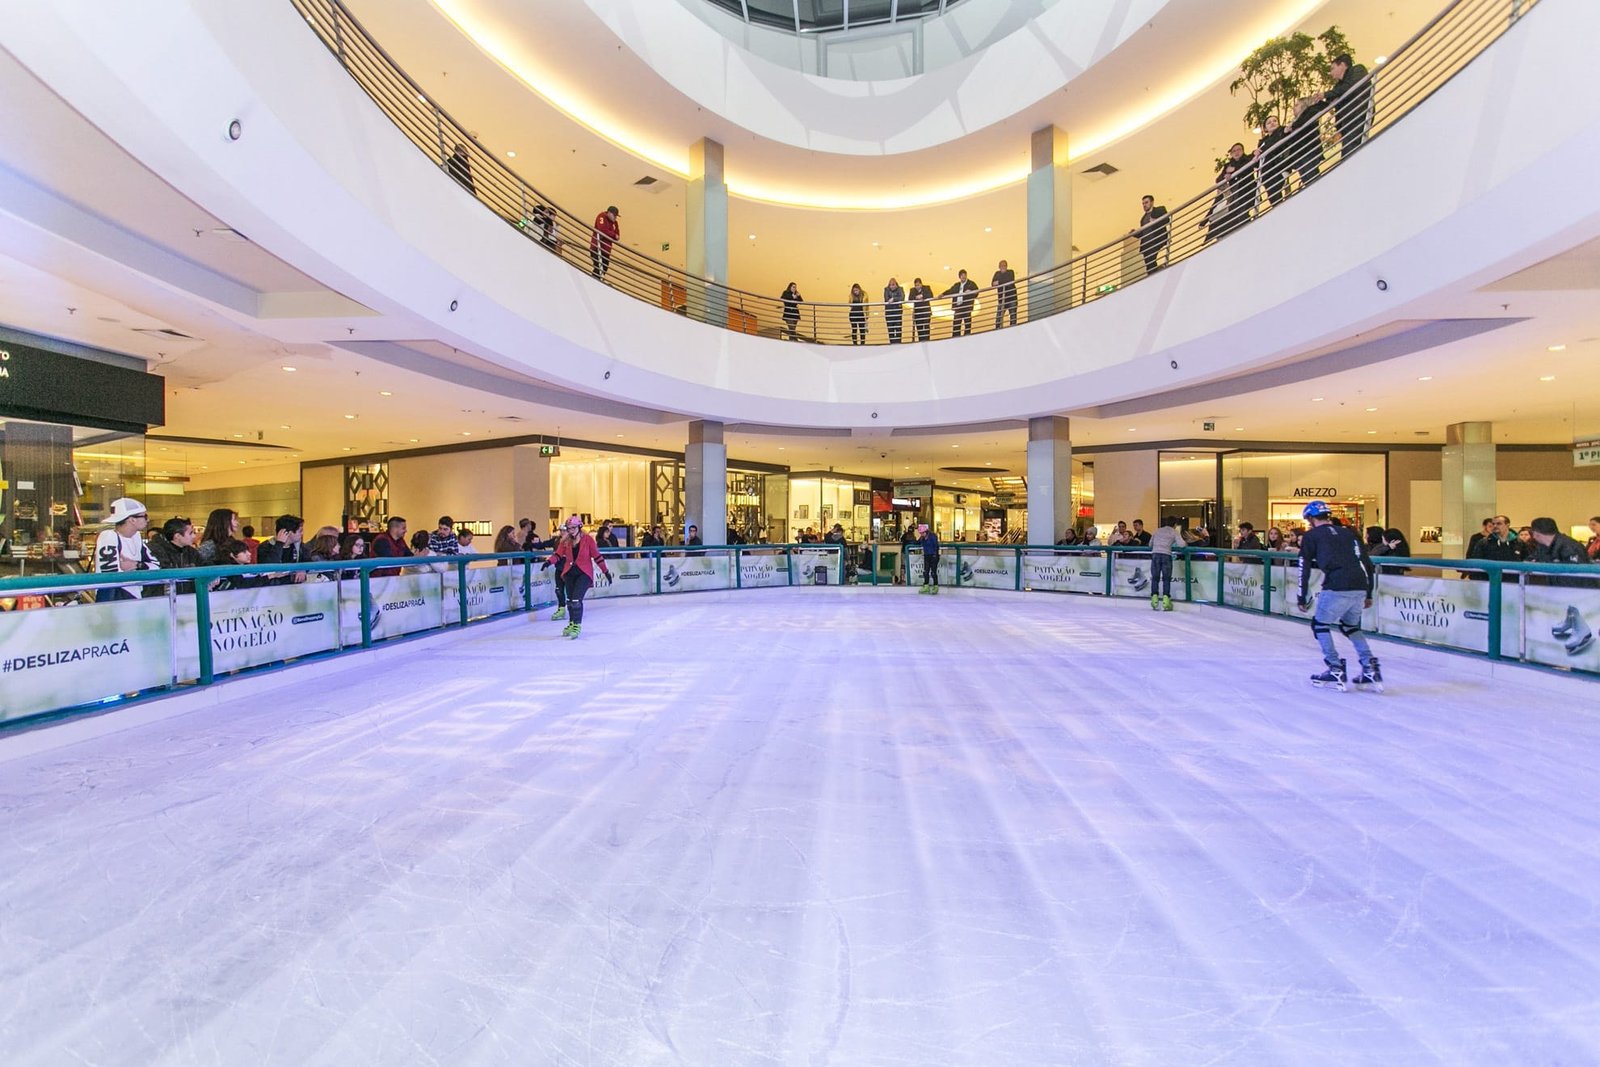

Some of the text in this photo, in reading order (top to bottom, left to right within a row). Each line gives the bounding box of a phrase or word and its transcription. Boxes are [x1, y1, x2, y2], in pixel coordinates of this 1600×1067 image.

[1293, 487, 1337, 498] AREZZO
[382, 595, 426, 611] #DESLIZAPRACÁ
[1394, 596, 1456, 614] PATINAÇÃO
[1400, 611, 1415, 622] NO
[1416, 613, 1449, 628] GELO
[213, 630, 277, 652] NO GELO
[3, 639, 130, 672] #DESLIZAPRACÁ
